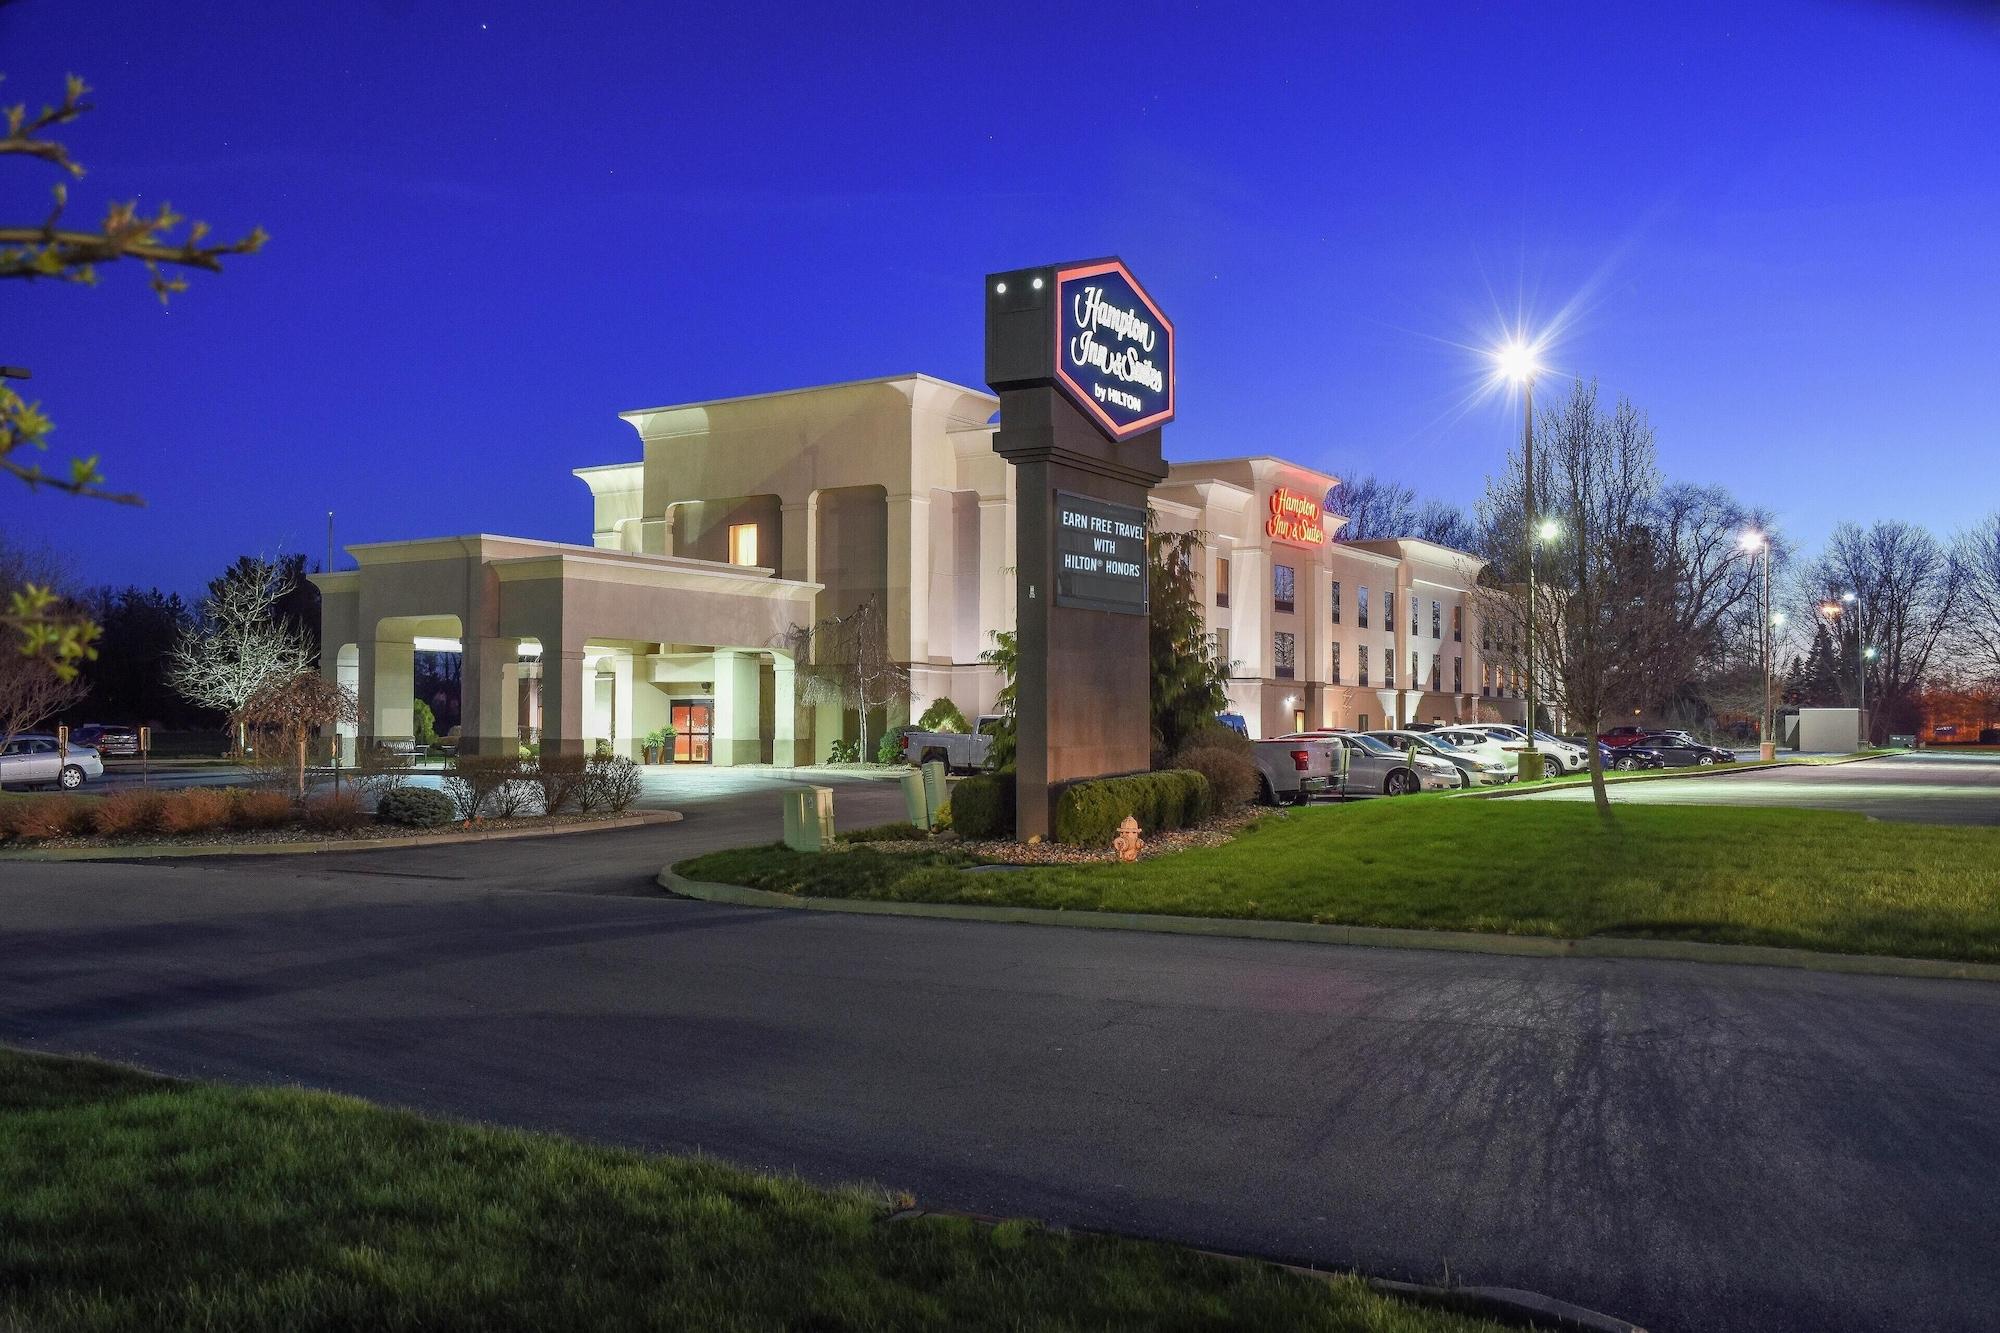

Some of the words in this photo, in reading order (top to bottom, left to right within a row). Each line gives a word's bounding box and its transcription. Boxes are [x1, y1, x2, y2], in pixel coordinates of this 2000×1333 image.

[1075, 287, 1155, 352] Hampton
[1071, 331, 1115, 374] Inn
[1122, 347, 1163, 392] Suites
[1094, 383, 1106, 402] by
[1108, 388, 1141, 412] HILTON
[1270, 487, 1319, 521] Hampton
[1063, 511, 1088, 529] EARN
[1091, 517, 1112, 534] FREE
[1114, 520, 1145, 540] TRAVEL
[1266, 514, 1292, 540] Inn
[1292, 523, 1299, 541] &
[1299, 519, 1323, 544] Suites
[1094, 538, 1115, 554] WITH
[1106, 560, 1140, 577] HONORS
